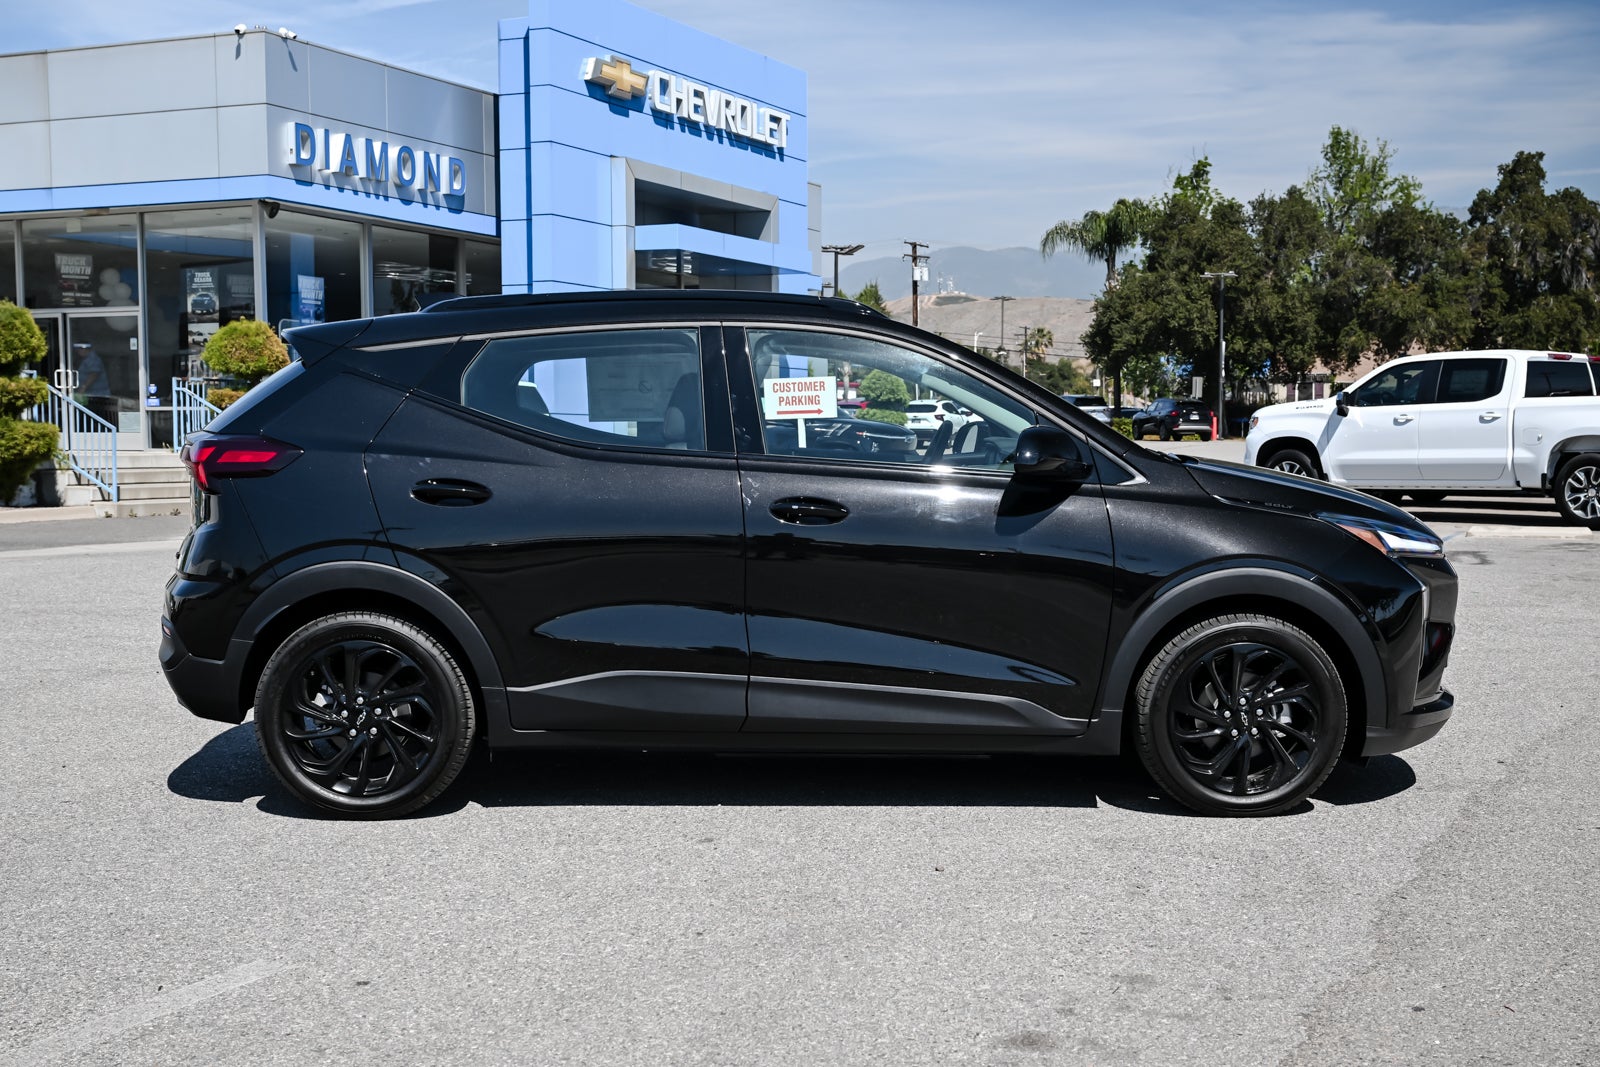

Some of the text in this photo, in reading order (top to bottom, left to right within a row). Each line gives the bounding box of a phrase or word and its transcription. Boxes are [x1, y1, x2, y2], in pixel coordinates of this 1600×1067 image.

[650, 69, 791, 148] CHEVROLET
[290, 121, 467, 197] DIAMOND
[57, 255, 86, 266] TRUCK
[60, 265, 92, 275] MONTH
[772, 380, 826, 393] CUSTOMER
[778, 394, 821, 407] PARKING
